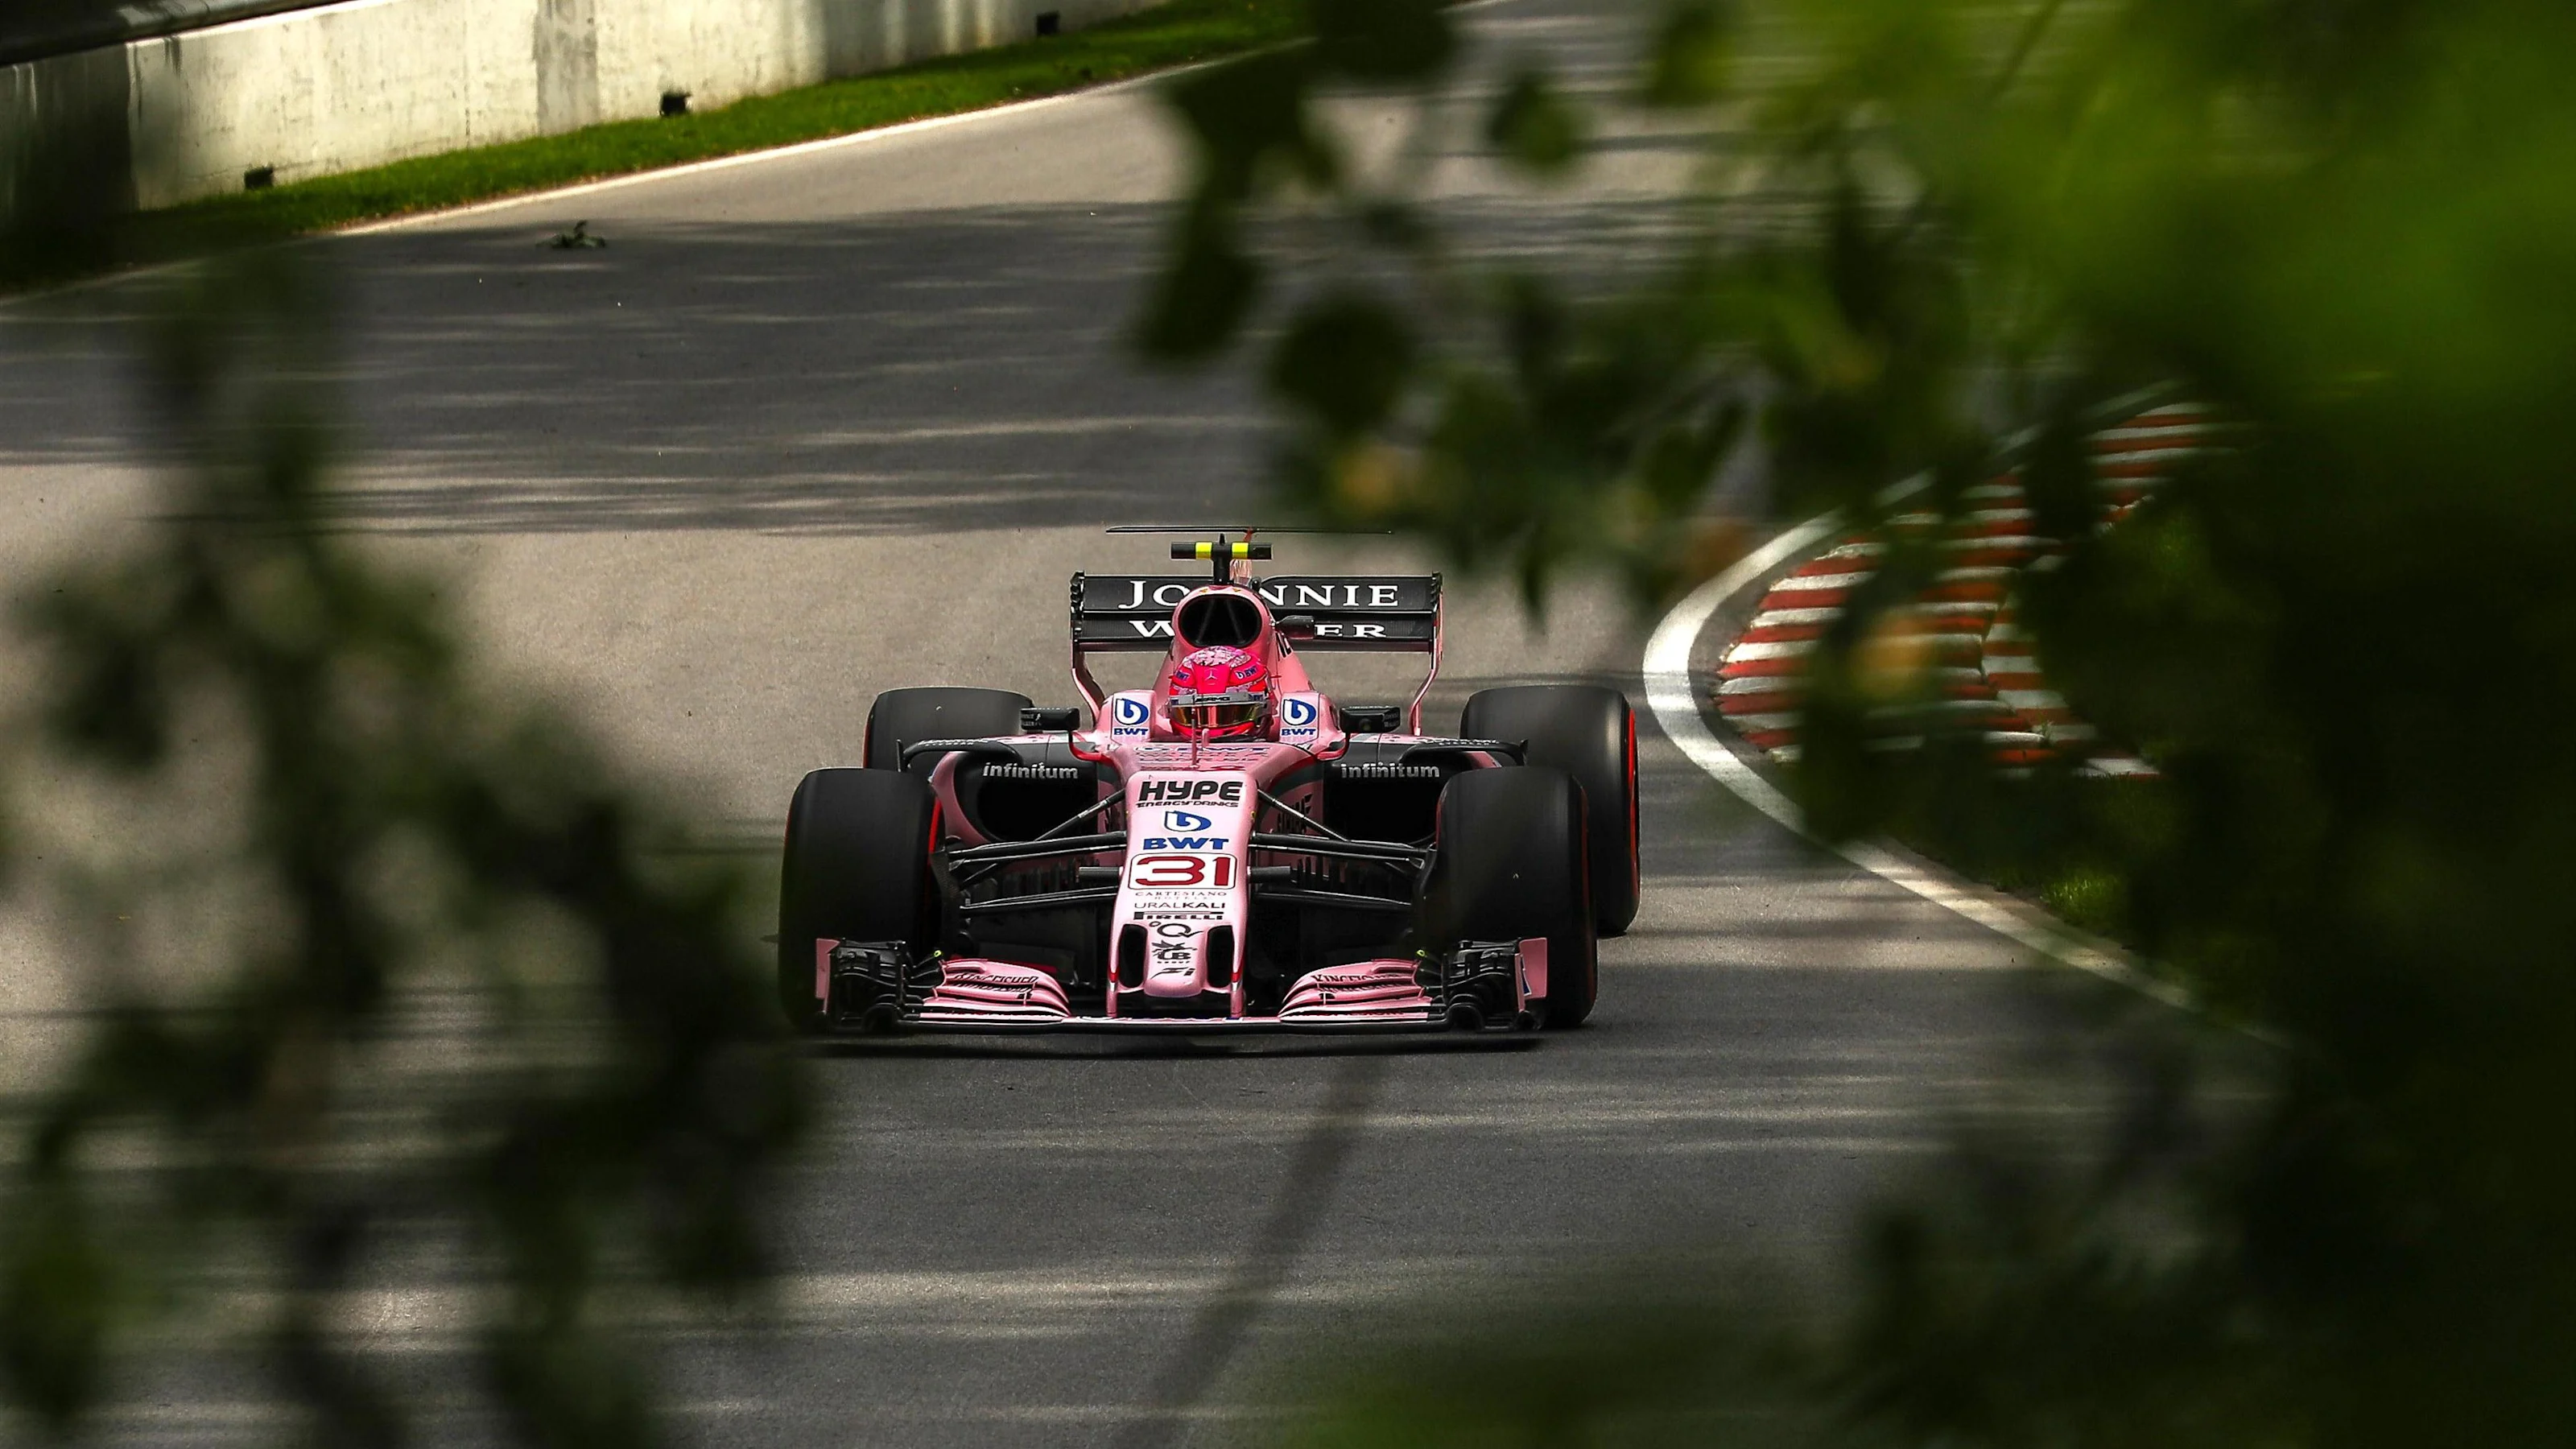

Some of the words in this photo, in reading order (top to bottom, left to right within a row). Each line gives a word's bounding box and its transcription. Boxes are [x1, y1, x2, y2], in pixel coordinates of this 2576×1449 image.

[1118, 580, 1398, 609] JONNIE
[1129, 620, 1387, 638] WER
[1281, 728, 1316, 736] BWT
[982, 762, 1079, 779] infinitum
[1341, 762, 1440, 779] infinitum
[1138, 781, 1243, 801] HYPE
[1143, 837, 1229, 850] BWT
[1135, 857, 1231, 886] 31
[1133, 911, 1224, 920] PIRELLI
